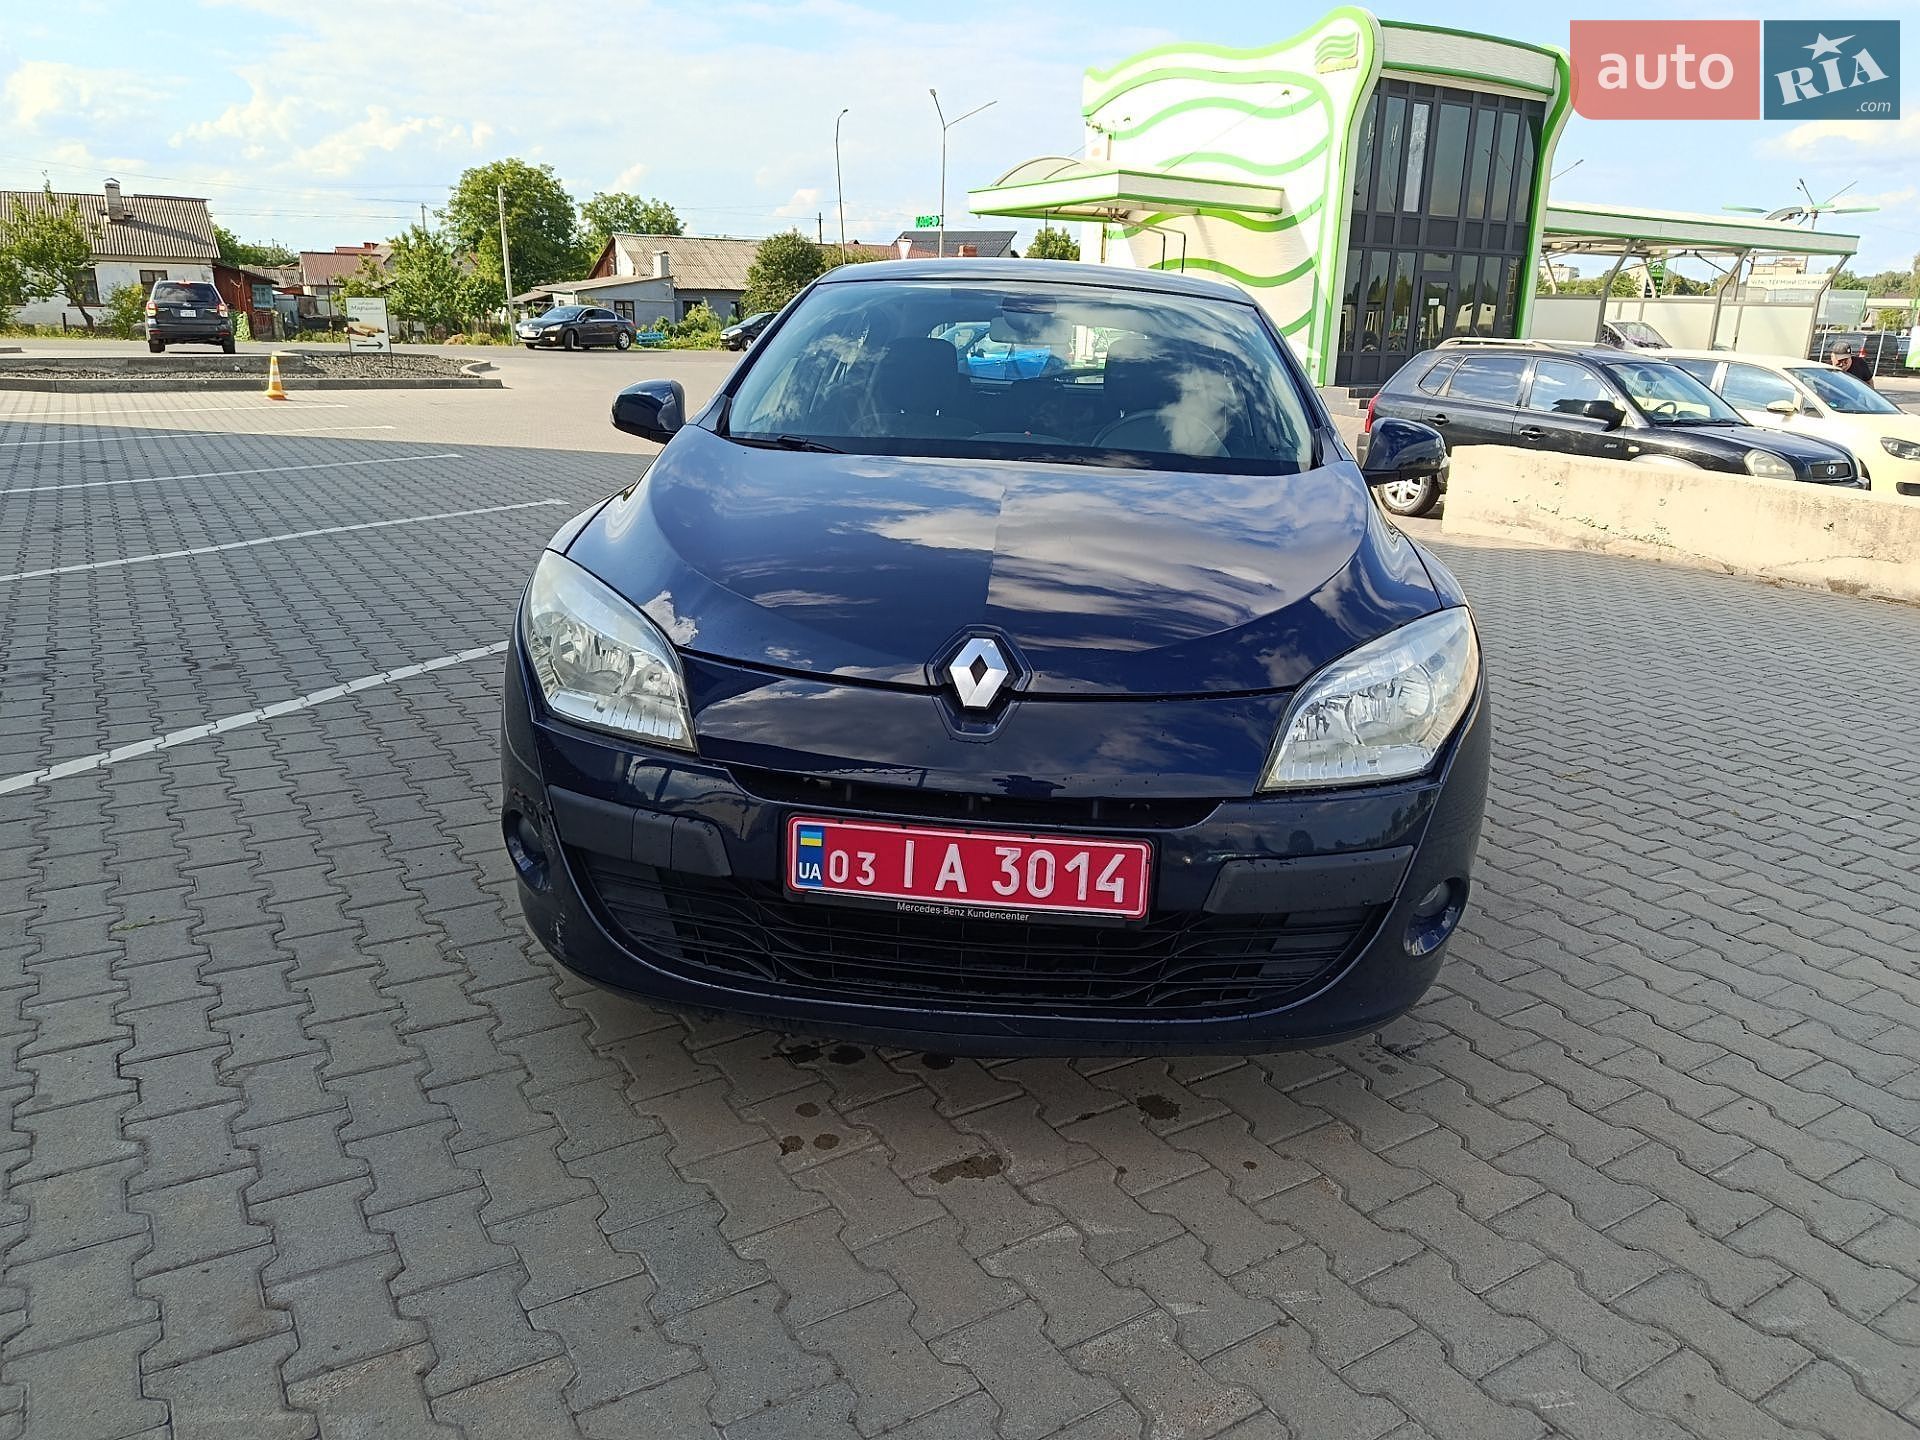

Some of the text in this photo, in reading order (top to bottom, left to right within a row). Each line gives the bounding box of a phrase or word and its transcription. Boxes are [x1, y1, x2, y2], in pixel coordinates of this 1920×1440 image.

[799, 862, 822, 881] UA
[829, 849, 876, 886] 03
[991, 846, 1126, 903] 3014
[896, 901, 1030, 921] Mercedes-Benz Kundencenter
